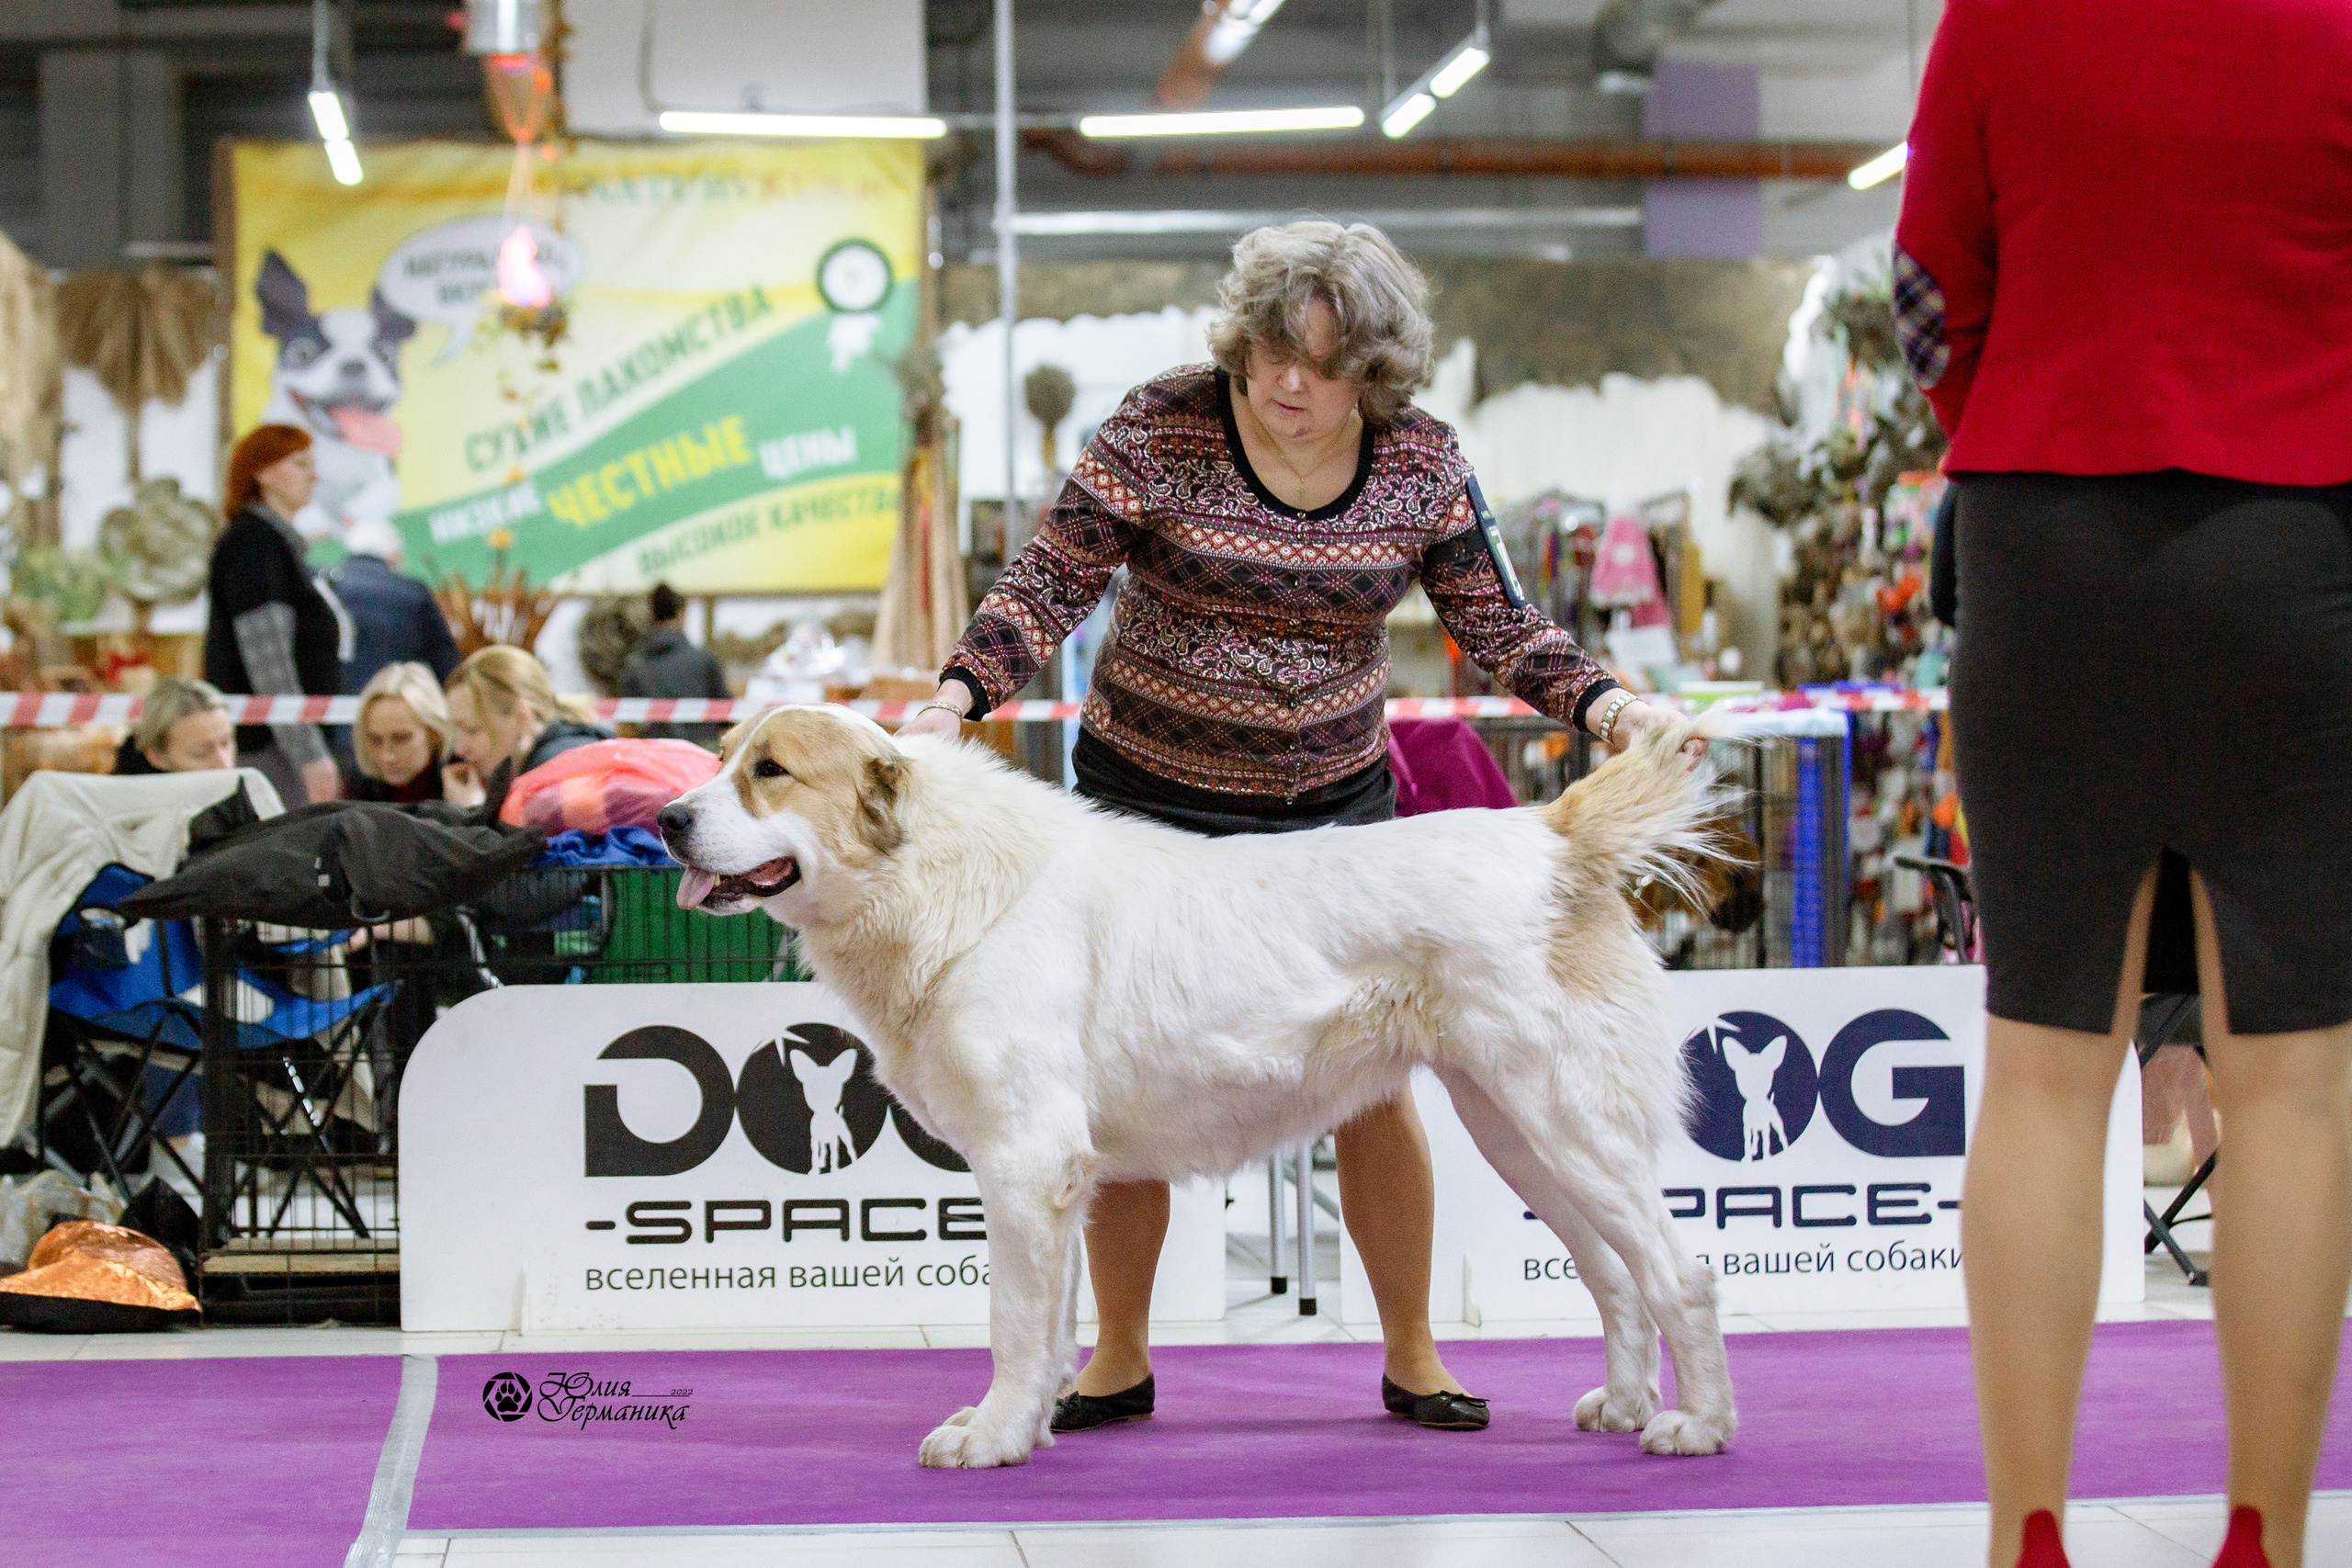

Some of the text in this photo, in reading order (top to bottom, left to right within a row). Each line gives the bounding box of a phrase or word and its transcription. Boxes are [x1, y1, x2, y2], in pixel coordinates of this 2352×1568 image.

[576, 283, 774, 418] ЛАКОМСТВА
[548, 414, 752, 526] ЧЕСТНЫЕ
[759, 426, 858, 480] ЦЕНЫ
[586, 1266, 775, 1291] вселенная
[790, 1257, 904, 1288] вашей
[1724, 1243, 1835, 1276] вашей
